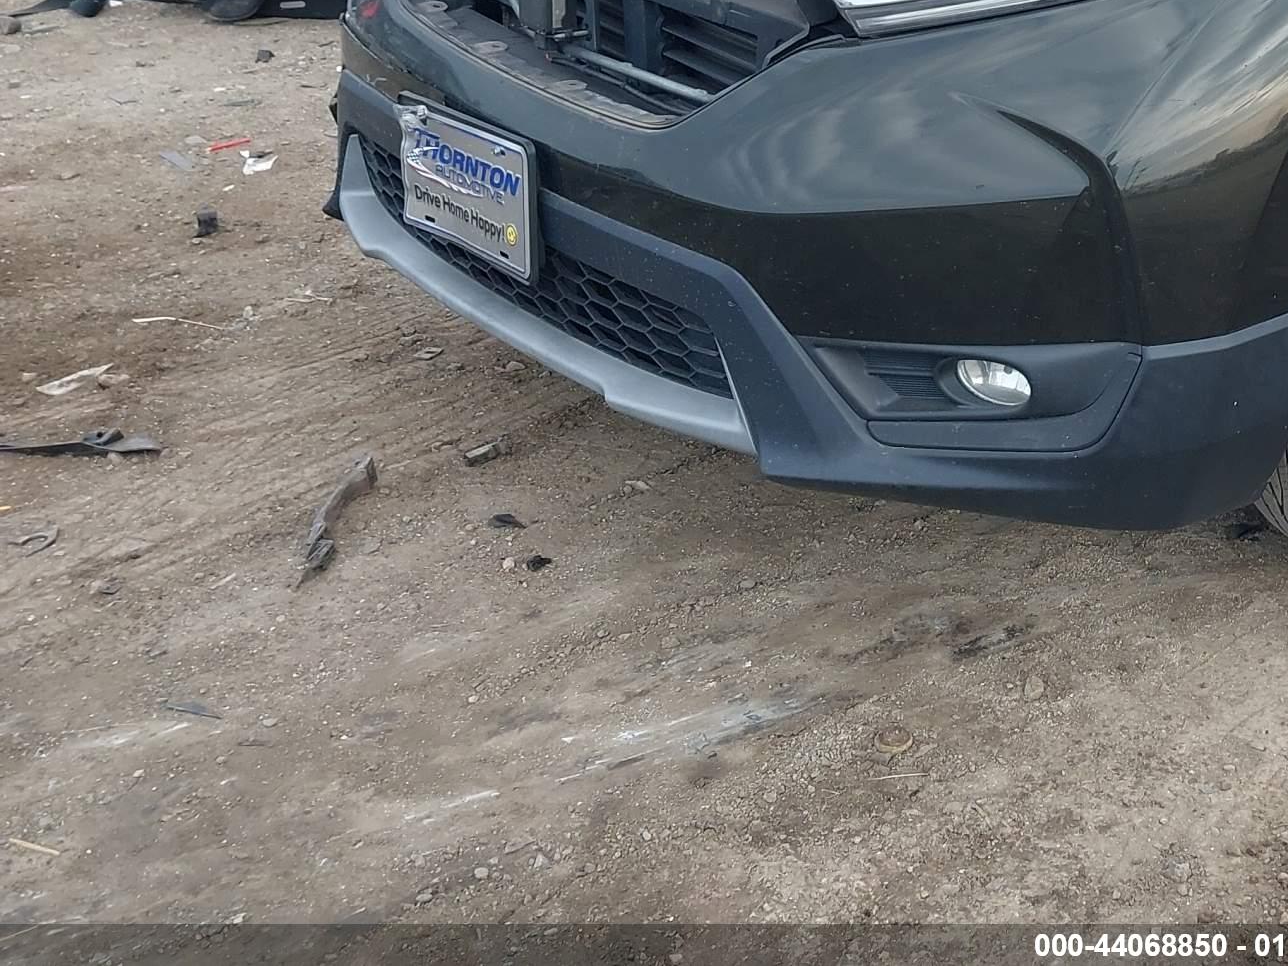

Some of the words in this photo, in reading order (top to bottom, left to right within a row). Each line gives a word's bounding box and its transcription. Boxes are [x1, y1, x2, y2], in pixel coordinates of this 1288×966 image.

[410, 127, 521, 198] THORNTON
[435, 164, 505, 205] AUTOMOTIVE
[414, 184, 441, 209] Drive
[442, 194, 470, 222] Home
[470, 209, 506, 243] Happy!
